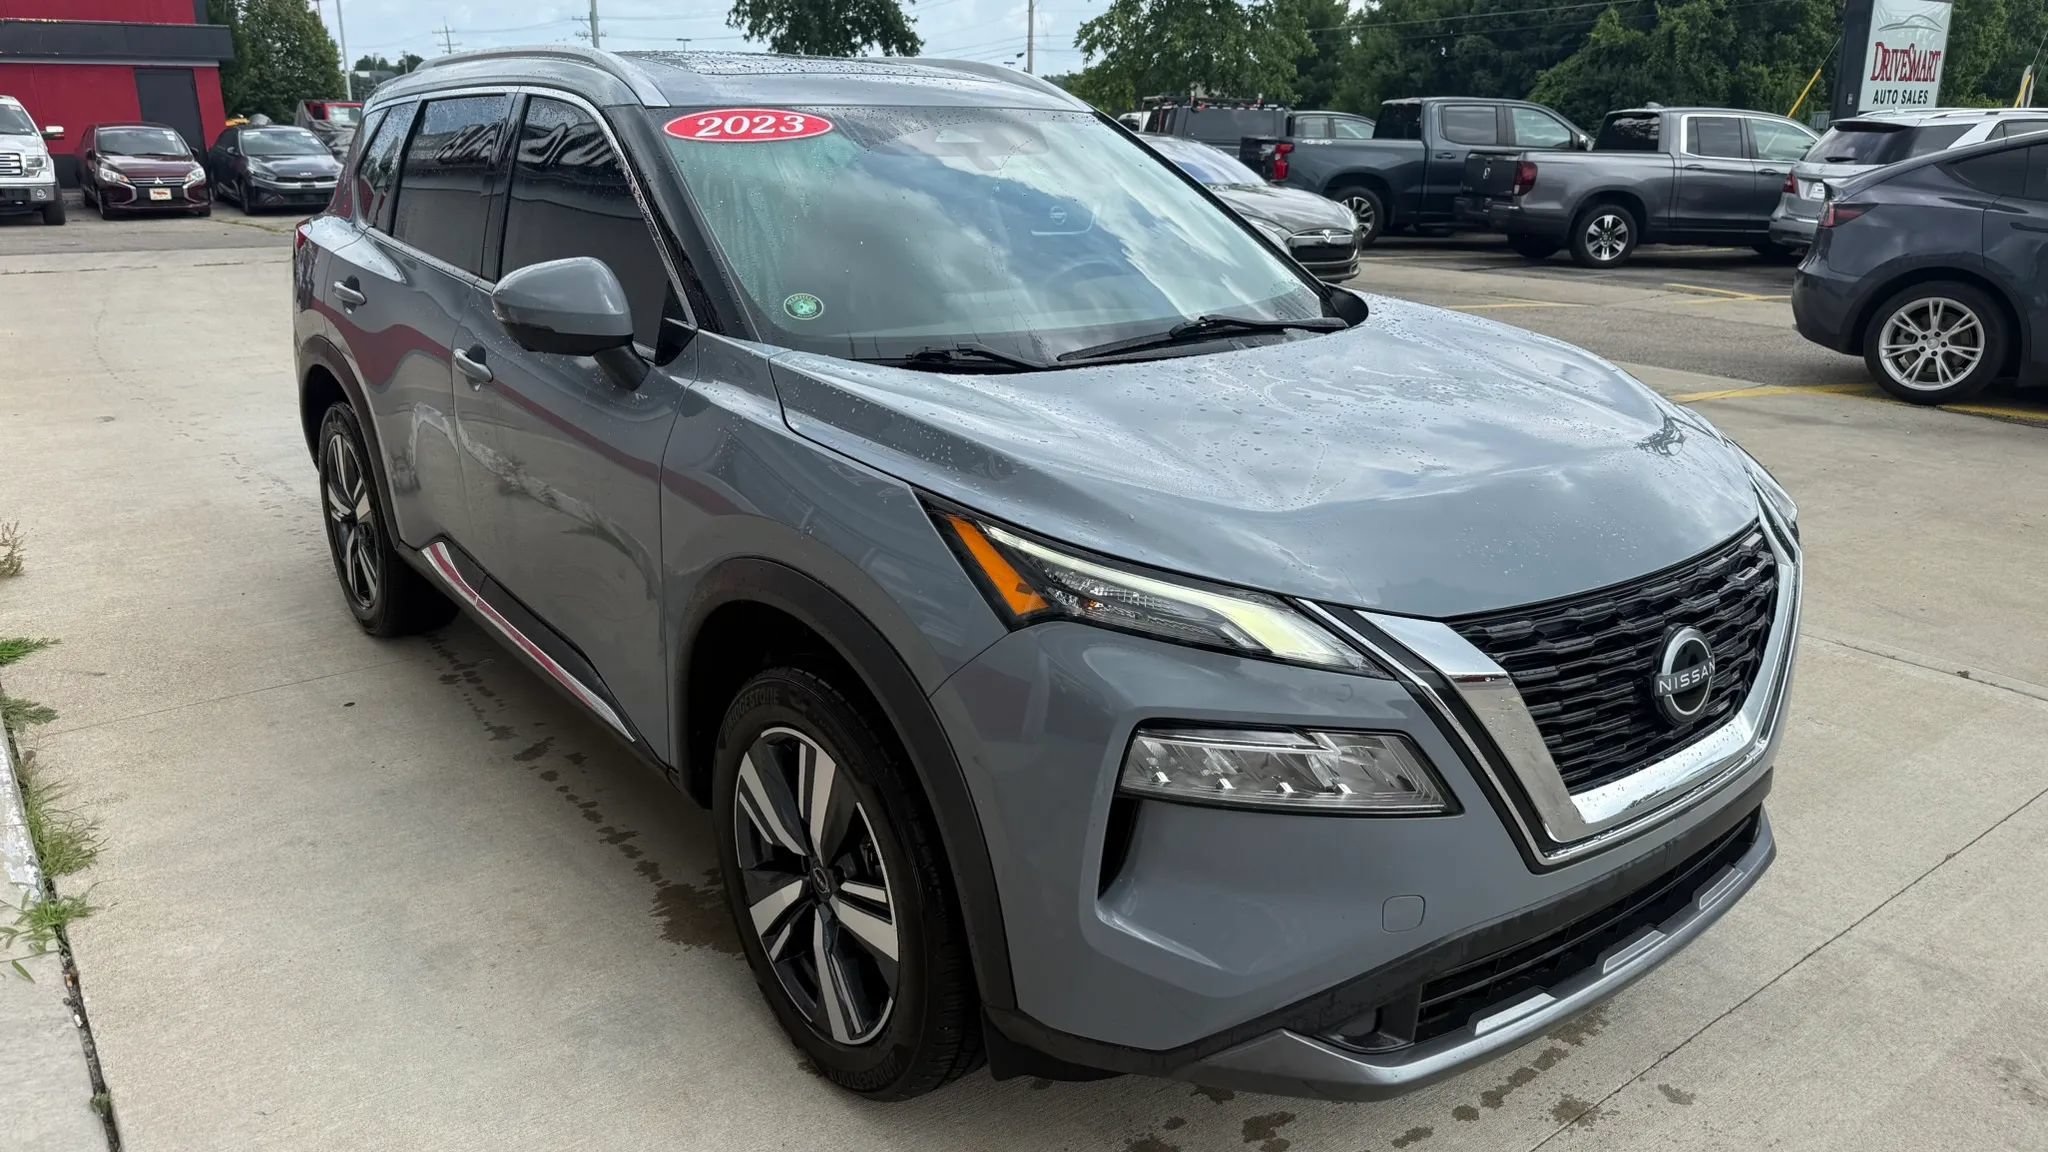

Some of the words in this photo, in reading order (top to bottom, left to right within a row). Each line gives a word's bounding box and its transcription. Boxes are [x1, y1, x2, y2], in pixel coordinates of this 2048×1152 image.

[1872, 89, 1898, 104] AUTO
[1901, 89, 1929, 104] SALES
[695, 115, 805, 137] 2023
[1659, 661, 1715, 693] NISSAN
